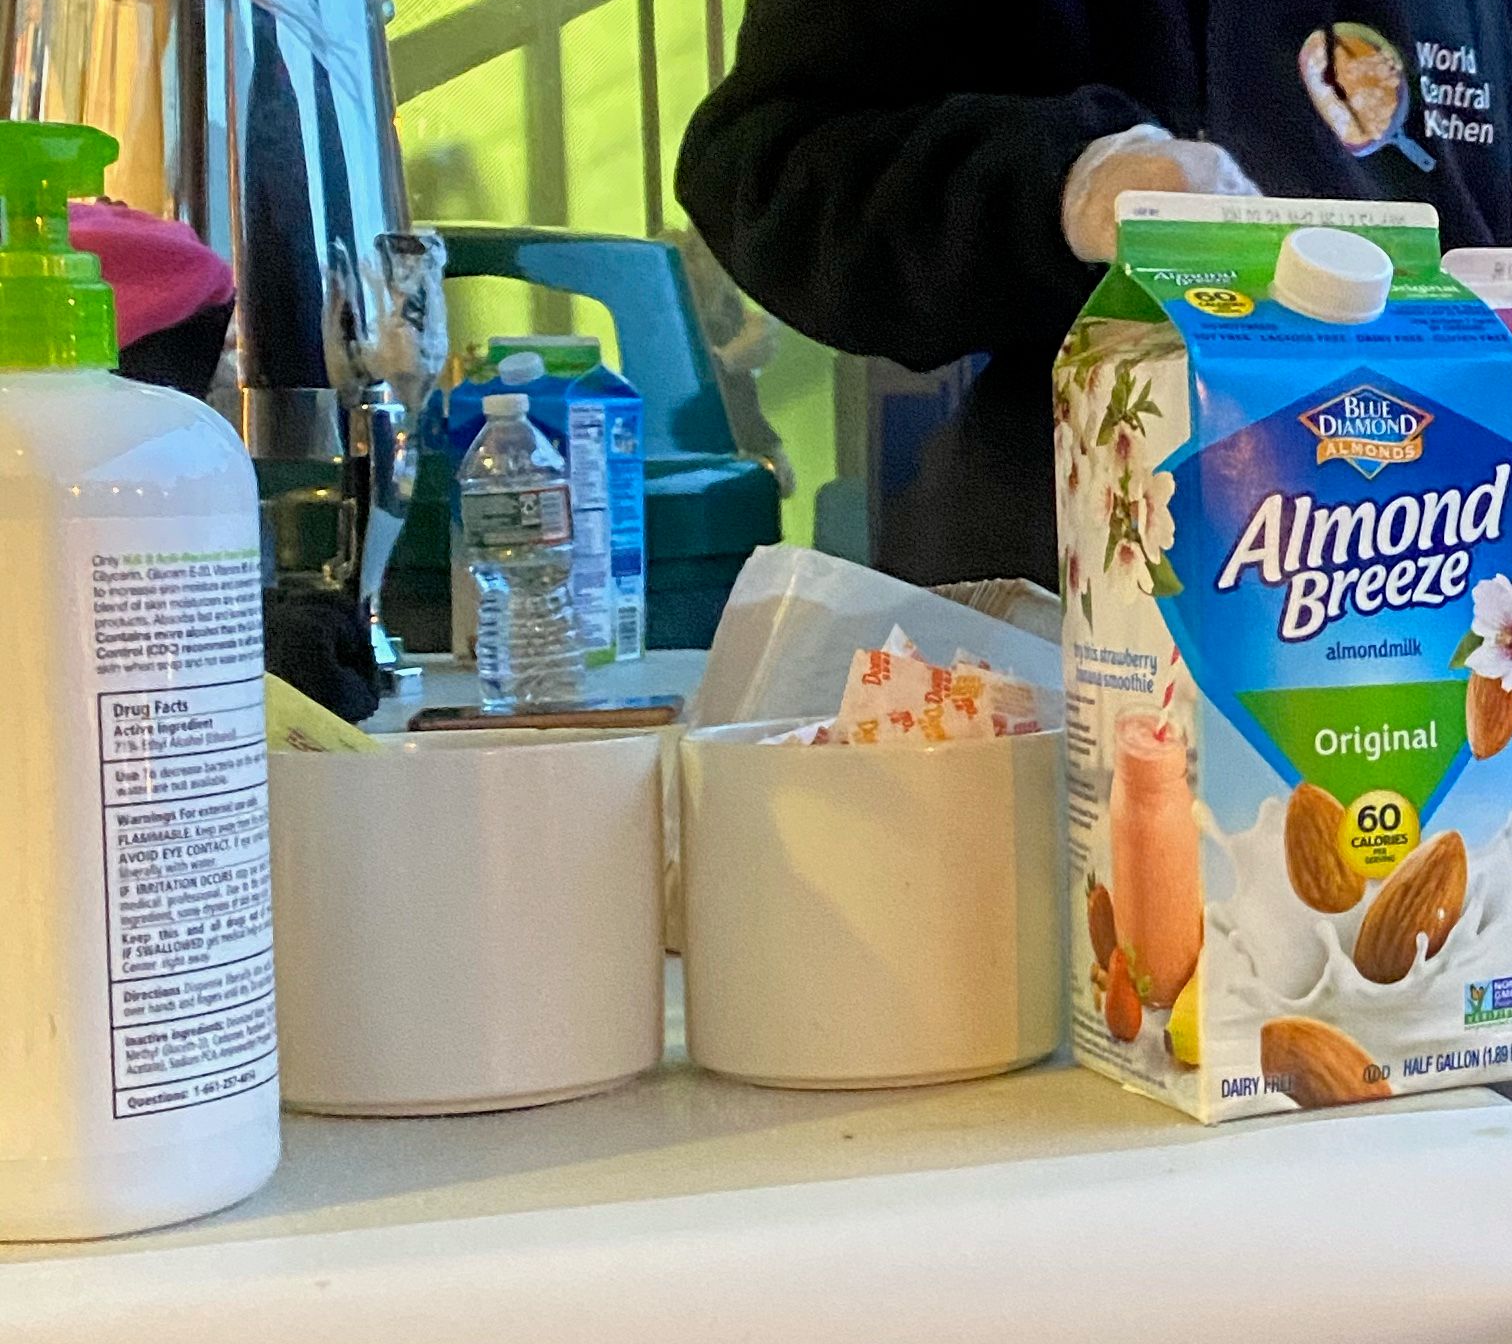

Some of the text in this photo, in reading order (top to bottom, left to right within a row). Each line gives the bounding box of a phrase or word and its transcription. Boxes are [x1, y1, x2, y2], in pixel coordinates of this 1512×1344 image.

[1416, 41, 1477, 74] World
[1420, 76, 1490, 109] Central
[1196, 291, 1237, 303] 60
[1345, 397, 1391, 418] BLUE
[1319, 413, 1418, 436] DIAMOND
[1325, 441, 1416, 459] ALMONDS
[1218, 462, 1511, 592] Almond
[1281, 549, 1472, 641] Breeze
[1326, 637, 1422, 662] almondmilk
[1100, 647, 1158, 676] strawberry
[1104, 672, 1154, 693] smoothie
[113, 699, 188, 719] Drug Facts
[113, 717, 214, 738] Active Ingredient
[1314, 721, 1438, 761] Original
[1357, 802, 1402, 833] 60
[1351, 833, 1408, 848] CALORIES
[118, 849, 159, 865] AVOID
[162, 845, 183, 861] EYE
[1403, 1055, 1433, 1078] HALF
[1436, 1049, 1481, 1073] GALLON
[1483, 1045, 1508, 1069] (1.89
[1221, 1076, 1260, 1099] DAIRY
